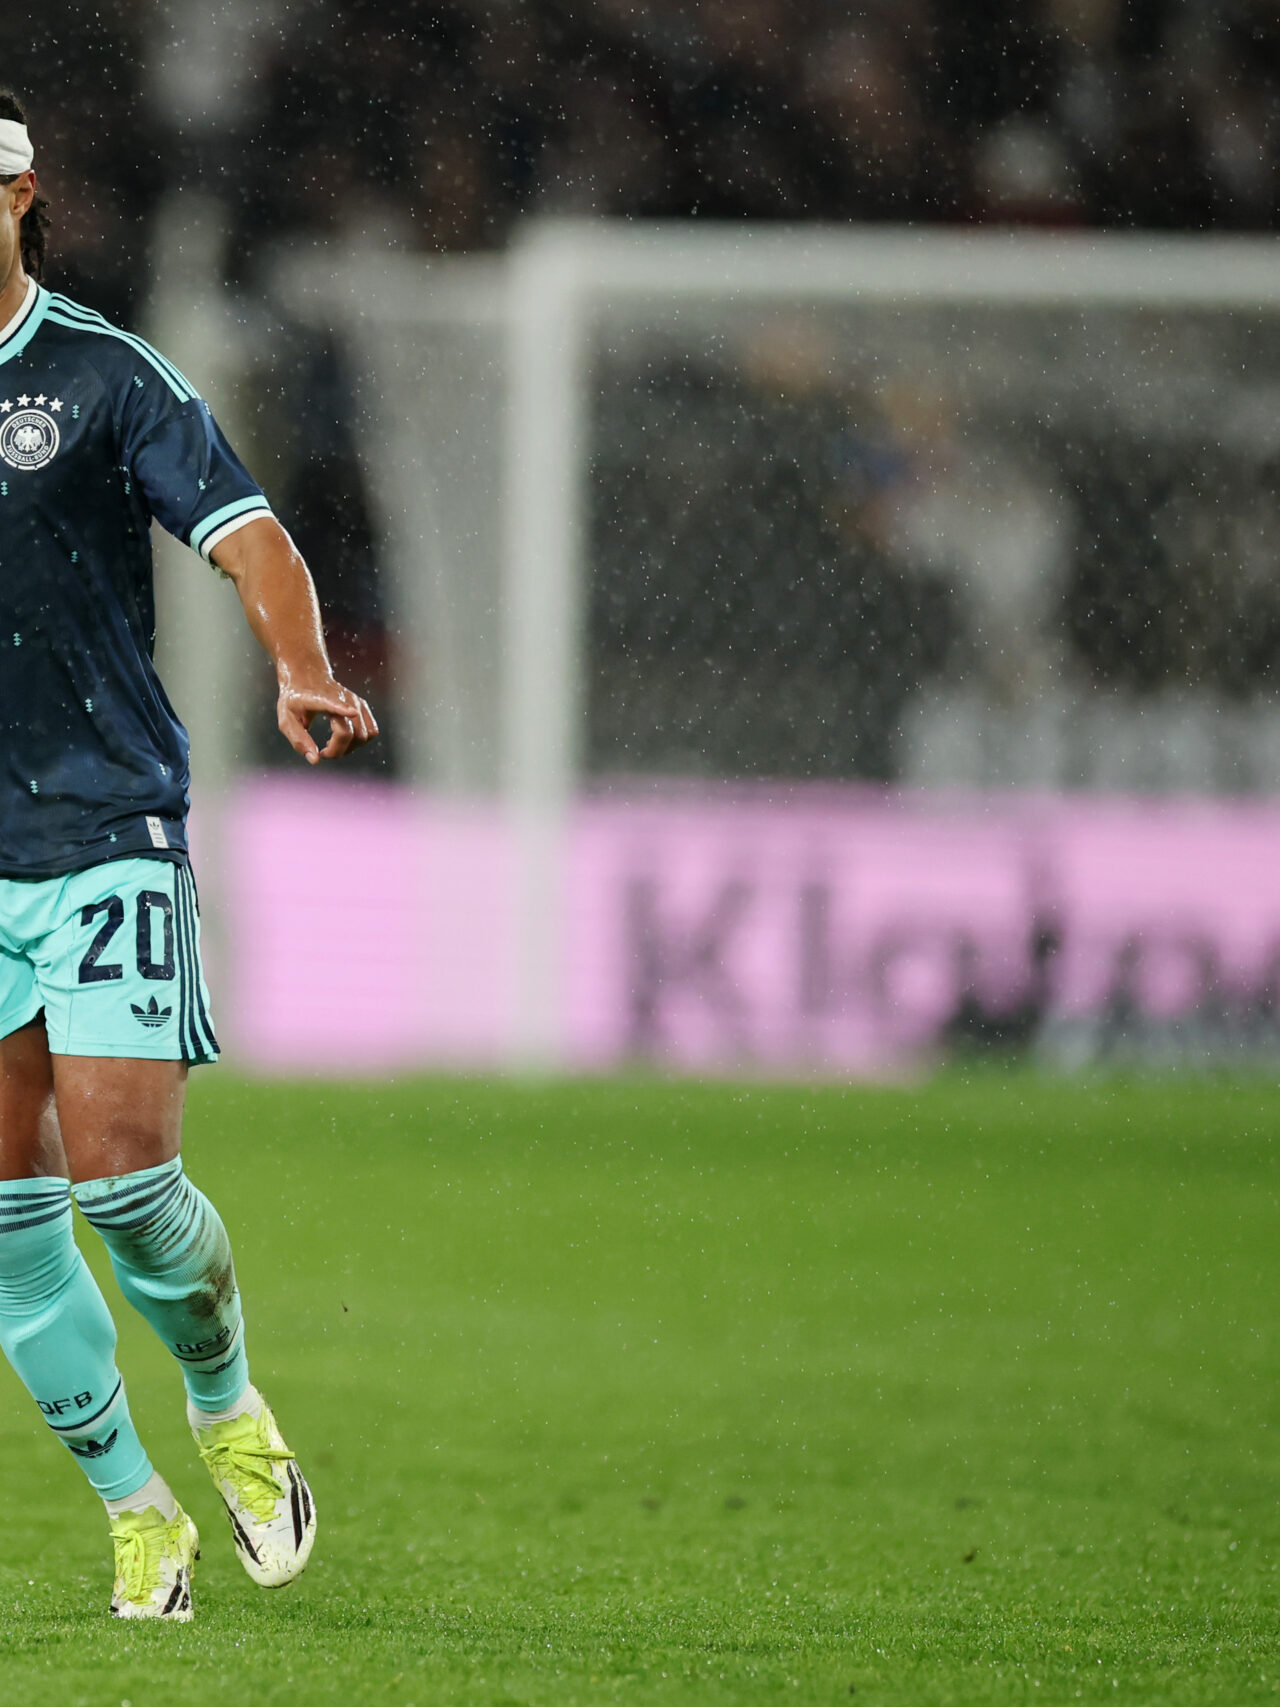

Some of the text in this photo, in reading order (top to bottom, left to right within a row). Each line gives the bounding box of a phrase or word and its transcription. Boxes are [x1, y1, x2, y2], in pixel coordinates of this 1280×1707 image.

[11, 416, 47, 429] DEUTSCHER
[78, 890, 176, 984] 20
[35, 1391, 93, 1415] DFB
